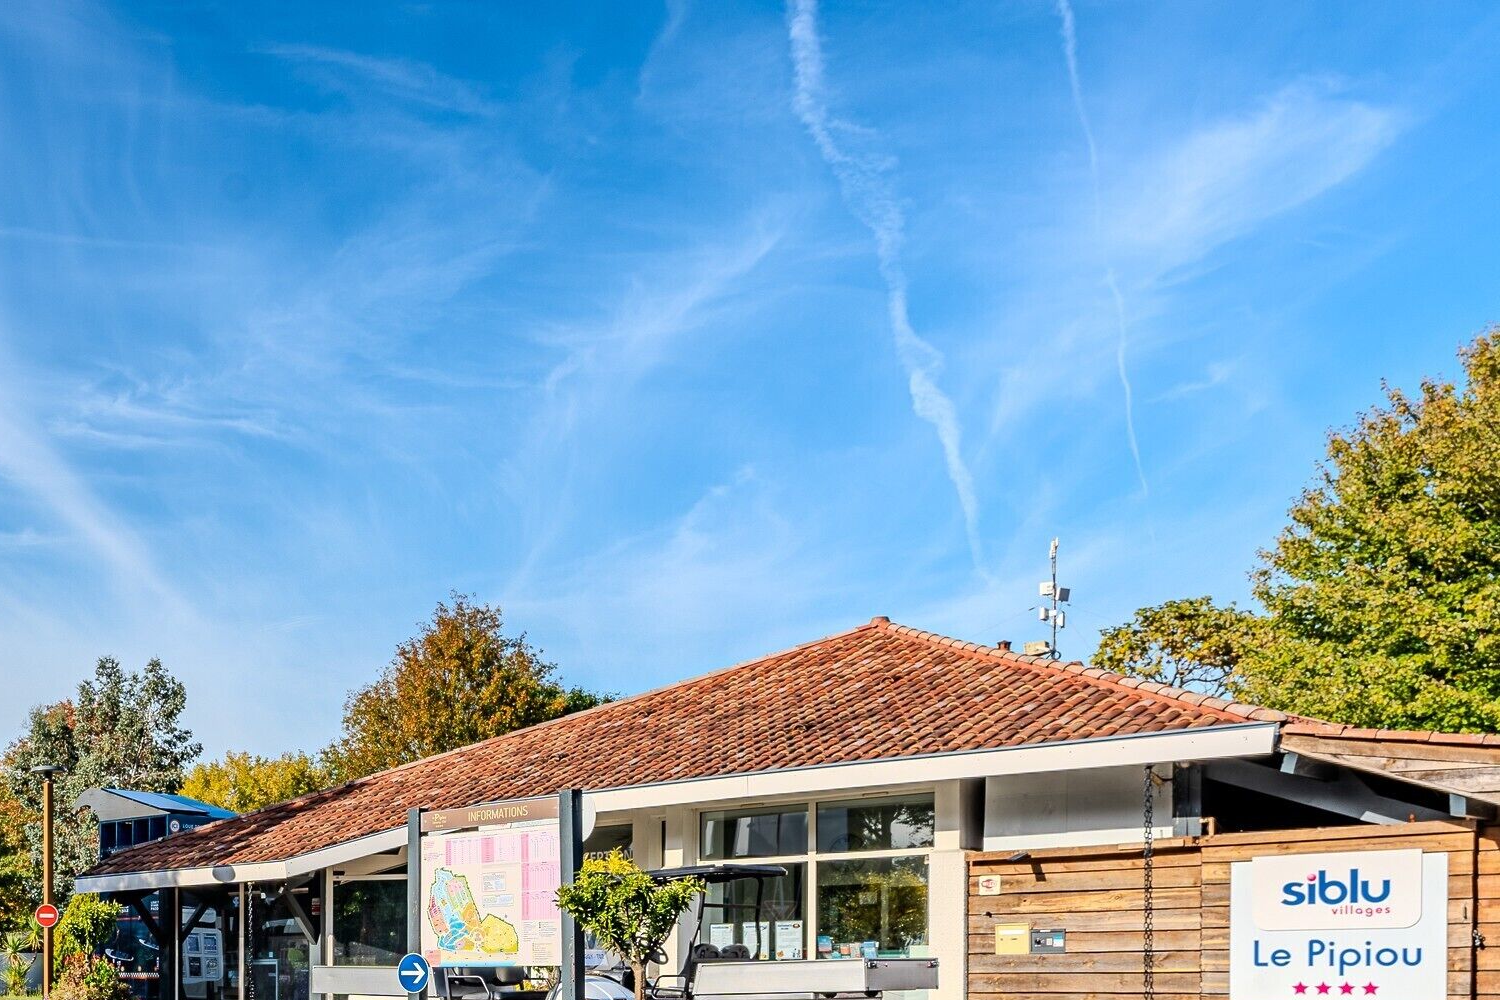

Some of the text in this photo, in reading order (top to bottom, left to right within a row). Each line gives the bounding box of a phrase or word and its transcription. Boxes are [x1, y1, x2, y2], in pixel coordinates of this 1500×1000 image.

[467, 805, 529, 822] INFORMATIONS
[1280, 868, 1391, 906] siblu
[1331, 905, 1391, 918] villages
[1253, 939, 1422, 976] Le Pipiou
